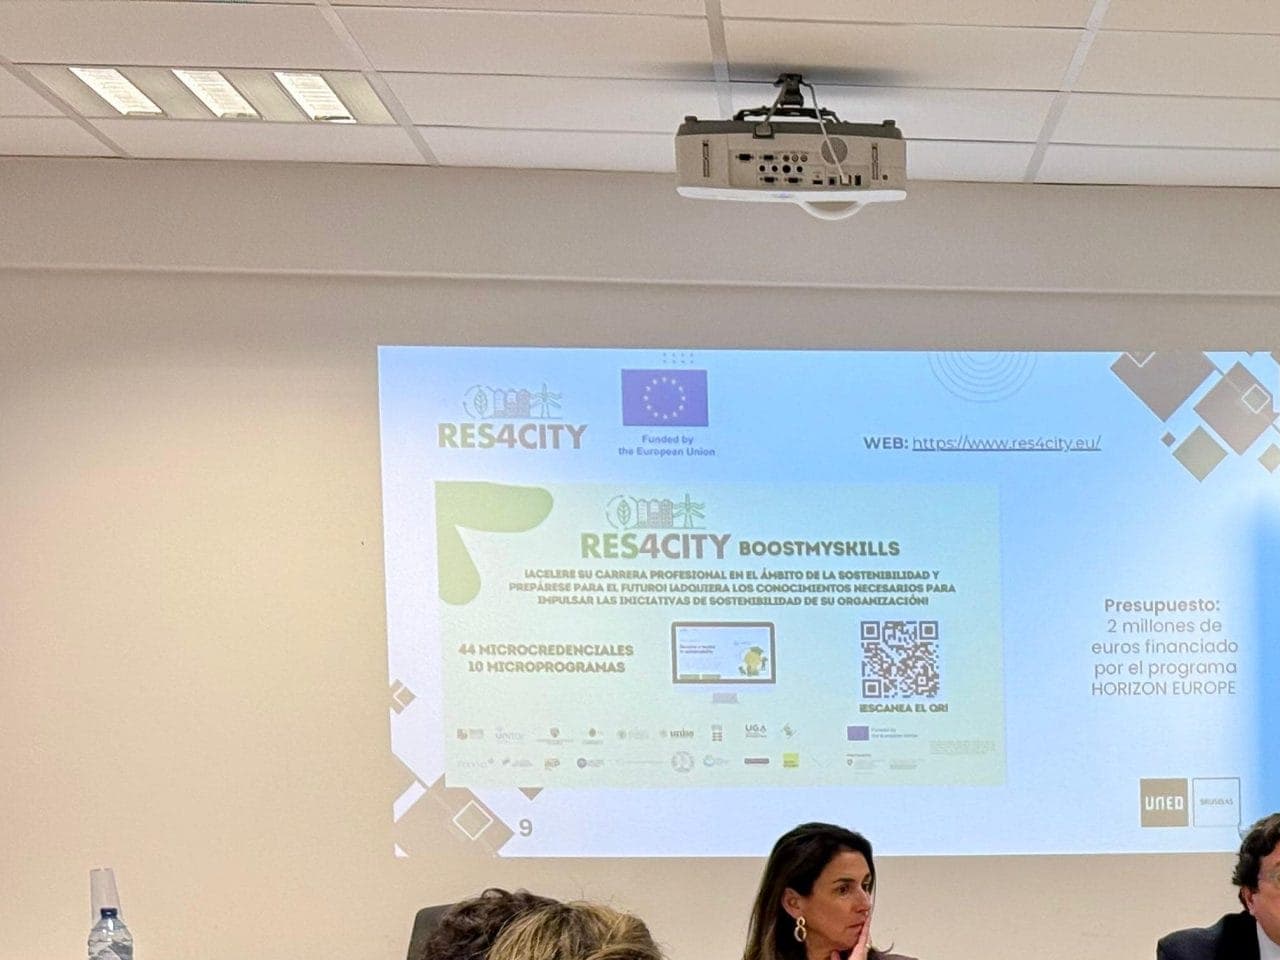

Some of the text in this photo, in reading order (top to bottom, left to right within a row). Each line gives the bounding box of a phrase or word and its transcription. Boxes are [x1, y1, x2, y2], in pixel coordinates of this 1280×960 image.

[437, 422, 588, 449] RES4CITY
[642, 434, 694, 447] Funded by
[863, 435, 1102, 452] WEB: https://www.res4city.eu/
[618, 446, 715, 459] the European Union
[580, 532, 901, 559] RES4CITY BOOSTMYSKILLS
[578, 570, 592, 579] SU
[595, 570, 648, 579] CARRERA
[650, 570, 727, 580] PROFESIONAL
[729, 571, 744, 580] EN
[746, 571, 759, 580] EL
[760, 568, 804, 580] ÁMBITO
[806, 571, 820, 580] DE
[822, 571, 836, 580] LA
[838, 571, 930, 580] SOSTENIBILIDAD
[930, 571, 939, 580] Y
[509, 581, 572, 592] PREPÁRESE
[573, 582, 604, 592] PARA
[606, 583, 619, 592] EL
[621, 583, 667, 593] FUTURO!
[732, 583, 754, 593] LOS
[756, 583, 851, 593] CONOCIMIENTOS
[853, 583, 924, 593] NECESARIOS
[926, 584, 956, 593] PARA
[537, 594, 929, 606] IMPULSAR LAS INICIATIVAS DE SOSTENIBILIDAD DE SU ORGANIZACIÓN!
[1104, 598, 1221, 616] Presupuesto:
[1107, 618, 1222, 633] 2 millones de
[458, 643, 635, 657] 44 MICROCREDENCIALES
[1091, 638, 1239, 654] euros financiado
[467, 660, 626, 673] 10 MICROPROGRAMAS
[1094, 660, 1237, 679] por el programa
[1091, 681, 1237, 696] HORIZON EUROPE
[915, 703, 927, 713] EL
[1145, 795, 1184, 811] UNED
[519, 818, 533, 837] 9
